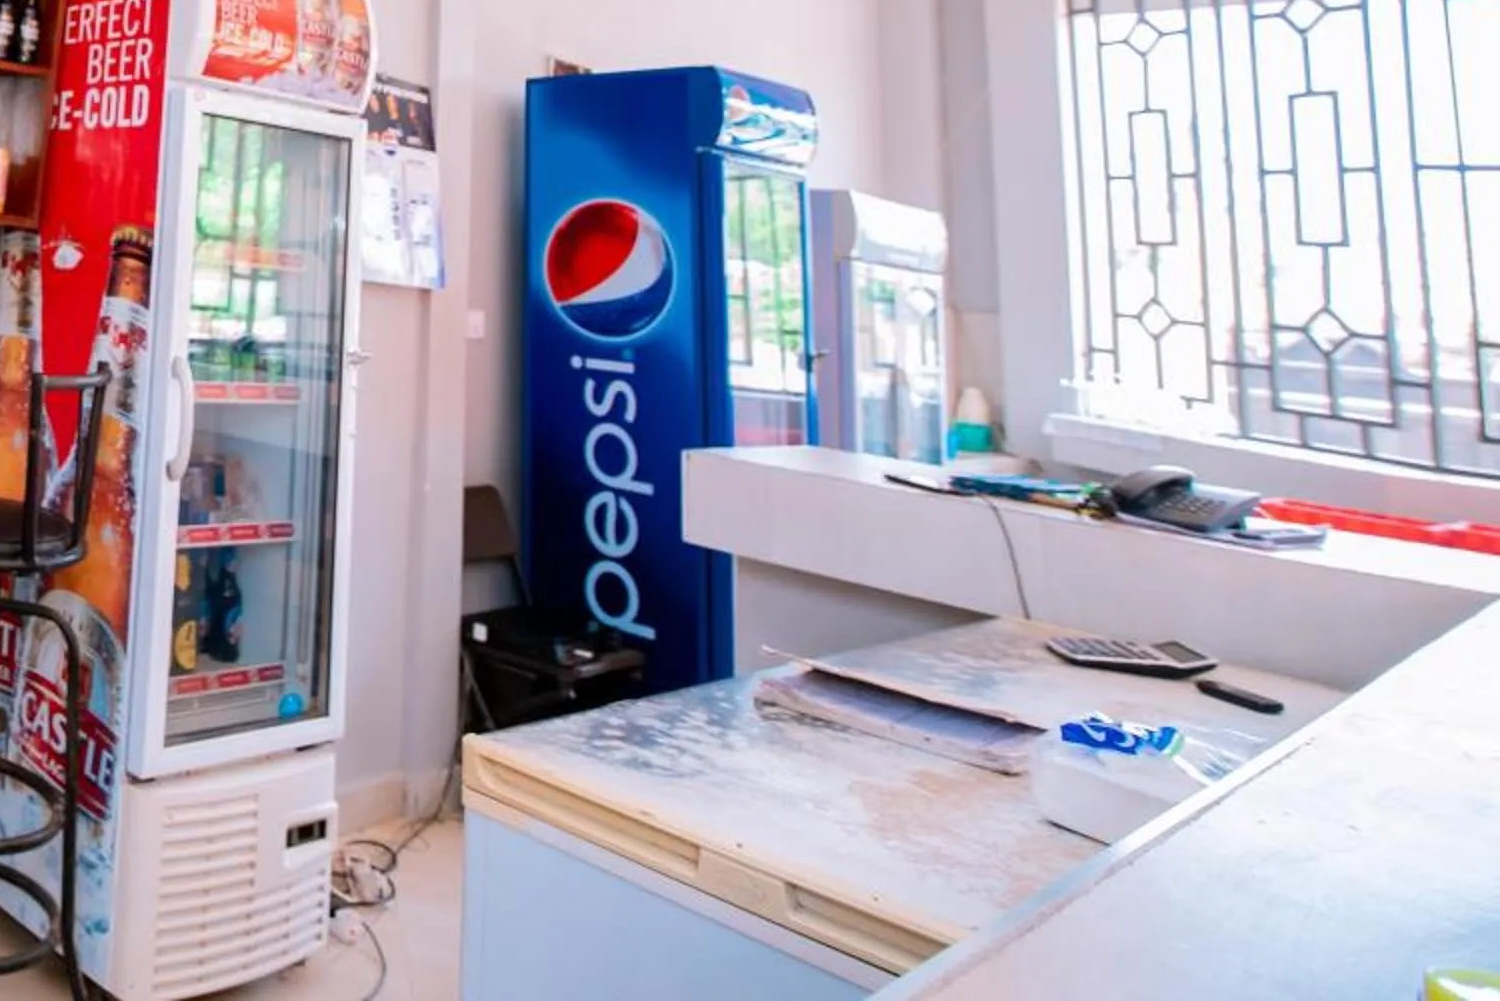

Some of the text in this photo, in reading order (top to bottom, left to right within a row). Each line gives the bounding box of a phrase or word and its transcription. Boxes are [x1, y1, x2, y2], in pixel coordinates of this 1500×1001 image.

[221, 0, 258, 26] BEER
[86, 37, 154, 85] BEER
[571, 353, 655, 640] pepsi
[21, 690, 117, 791] CASLE
